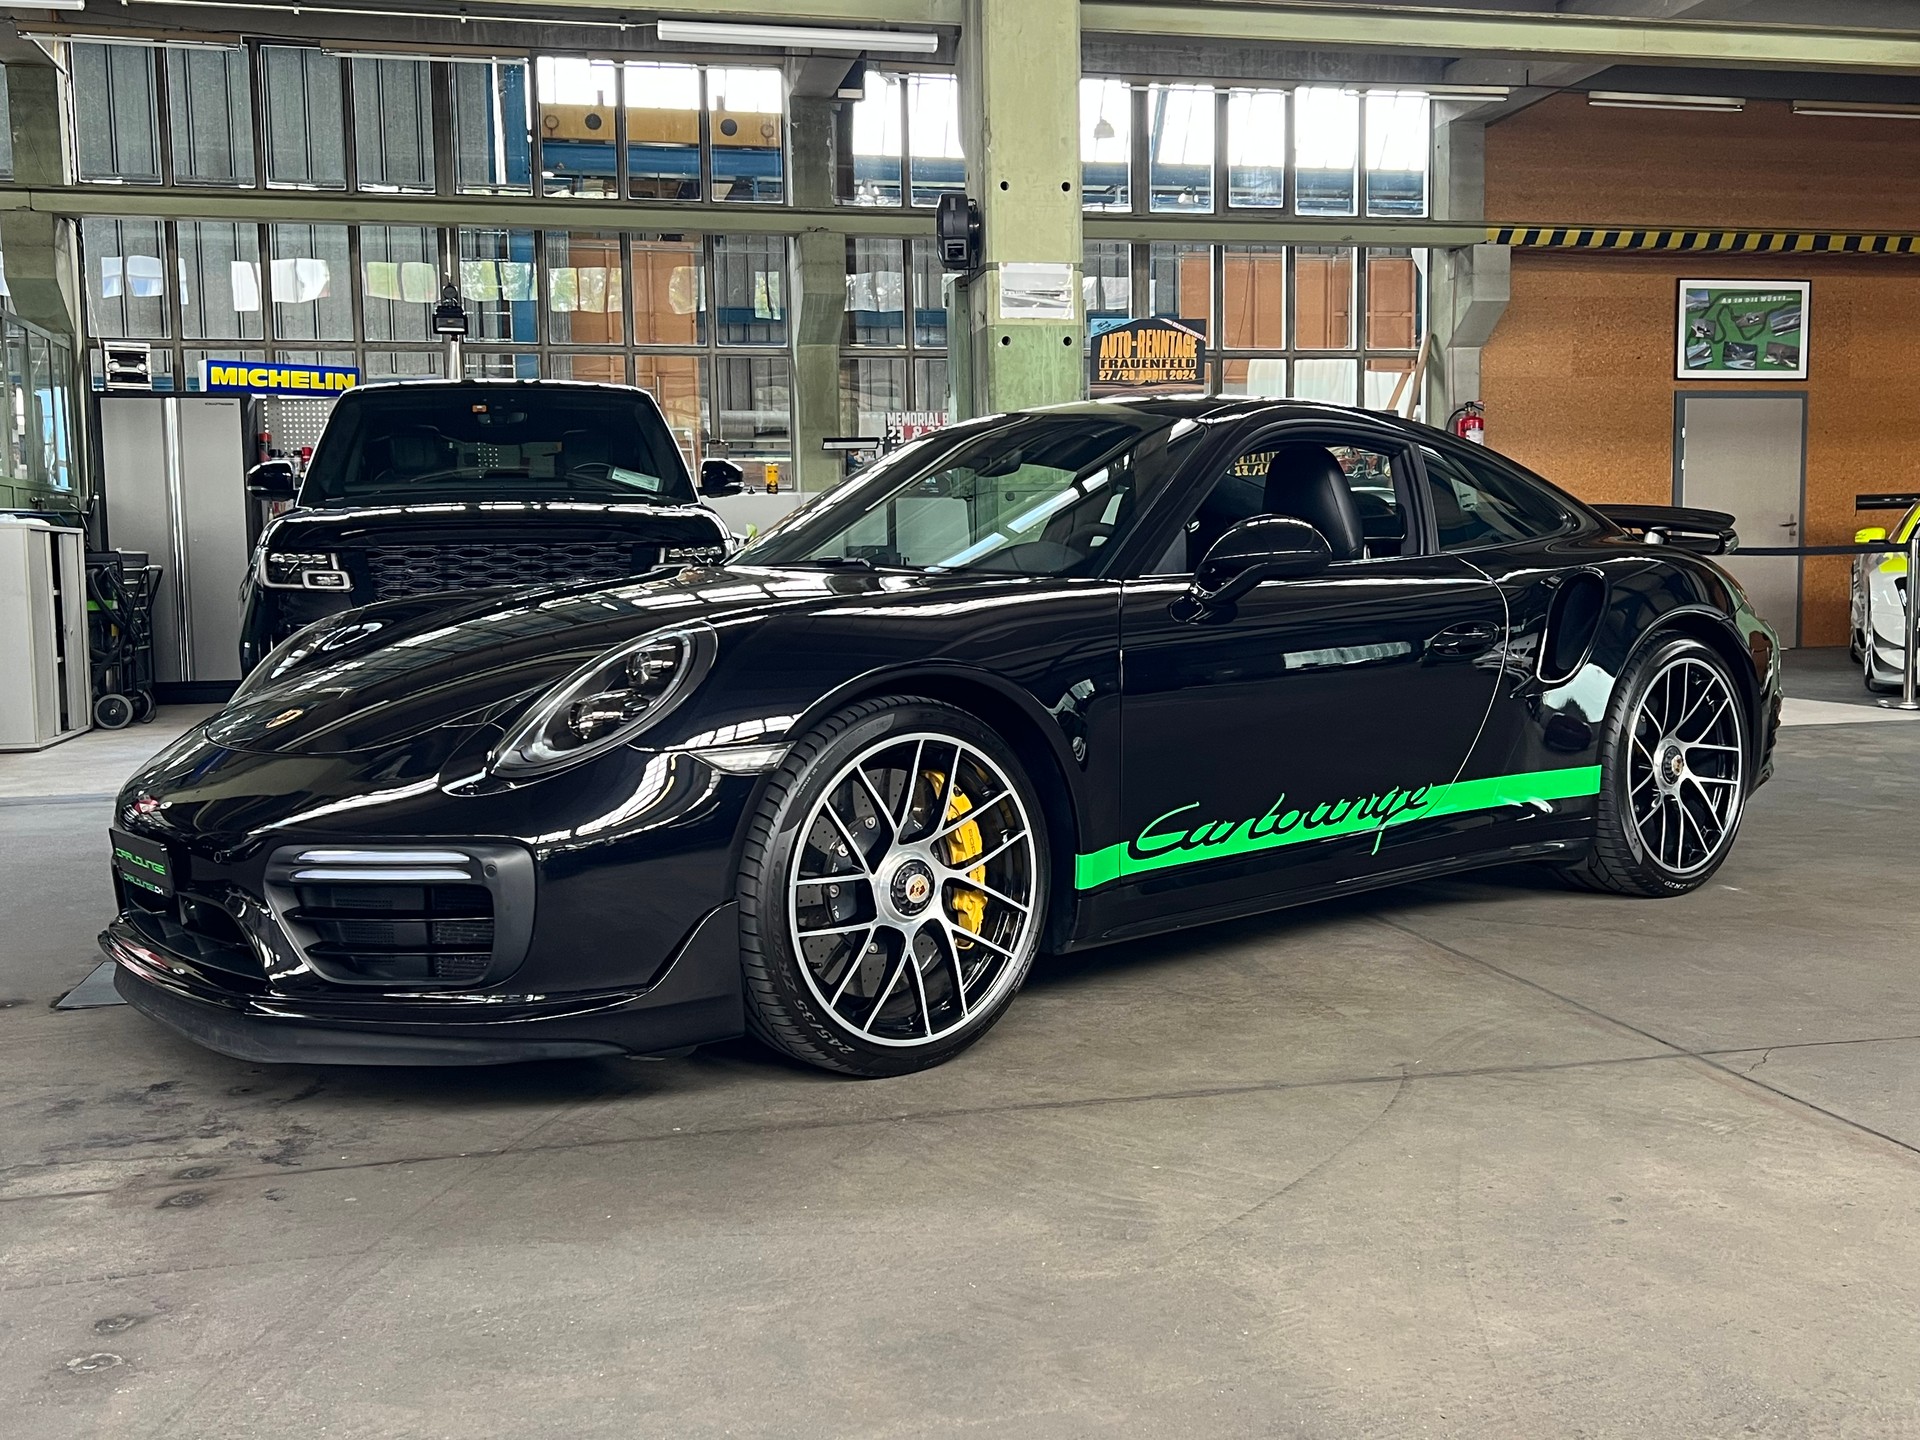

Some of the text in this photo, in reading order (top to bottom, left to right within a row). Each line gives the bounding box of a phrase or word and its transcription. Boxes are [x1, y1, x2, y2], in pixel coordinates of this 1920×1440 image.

[1100, 329, 1198, 358] AUTO-RENNTAGE
[1100, 358, 1196, 369] FRAUENFELD
[210, 366, 356, 390] MICHELIN
[1169, 370, 1196, 380] 2024
[887, 412, 941, 427] MEMORIAL
[115, 847, 166, 875] CARLOUNGE
